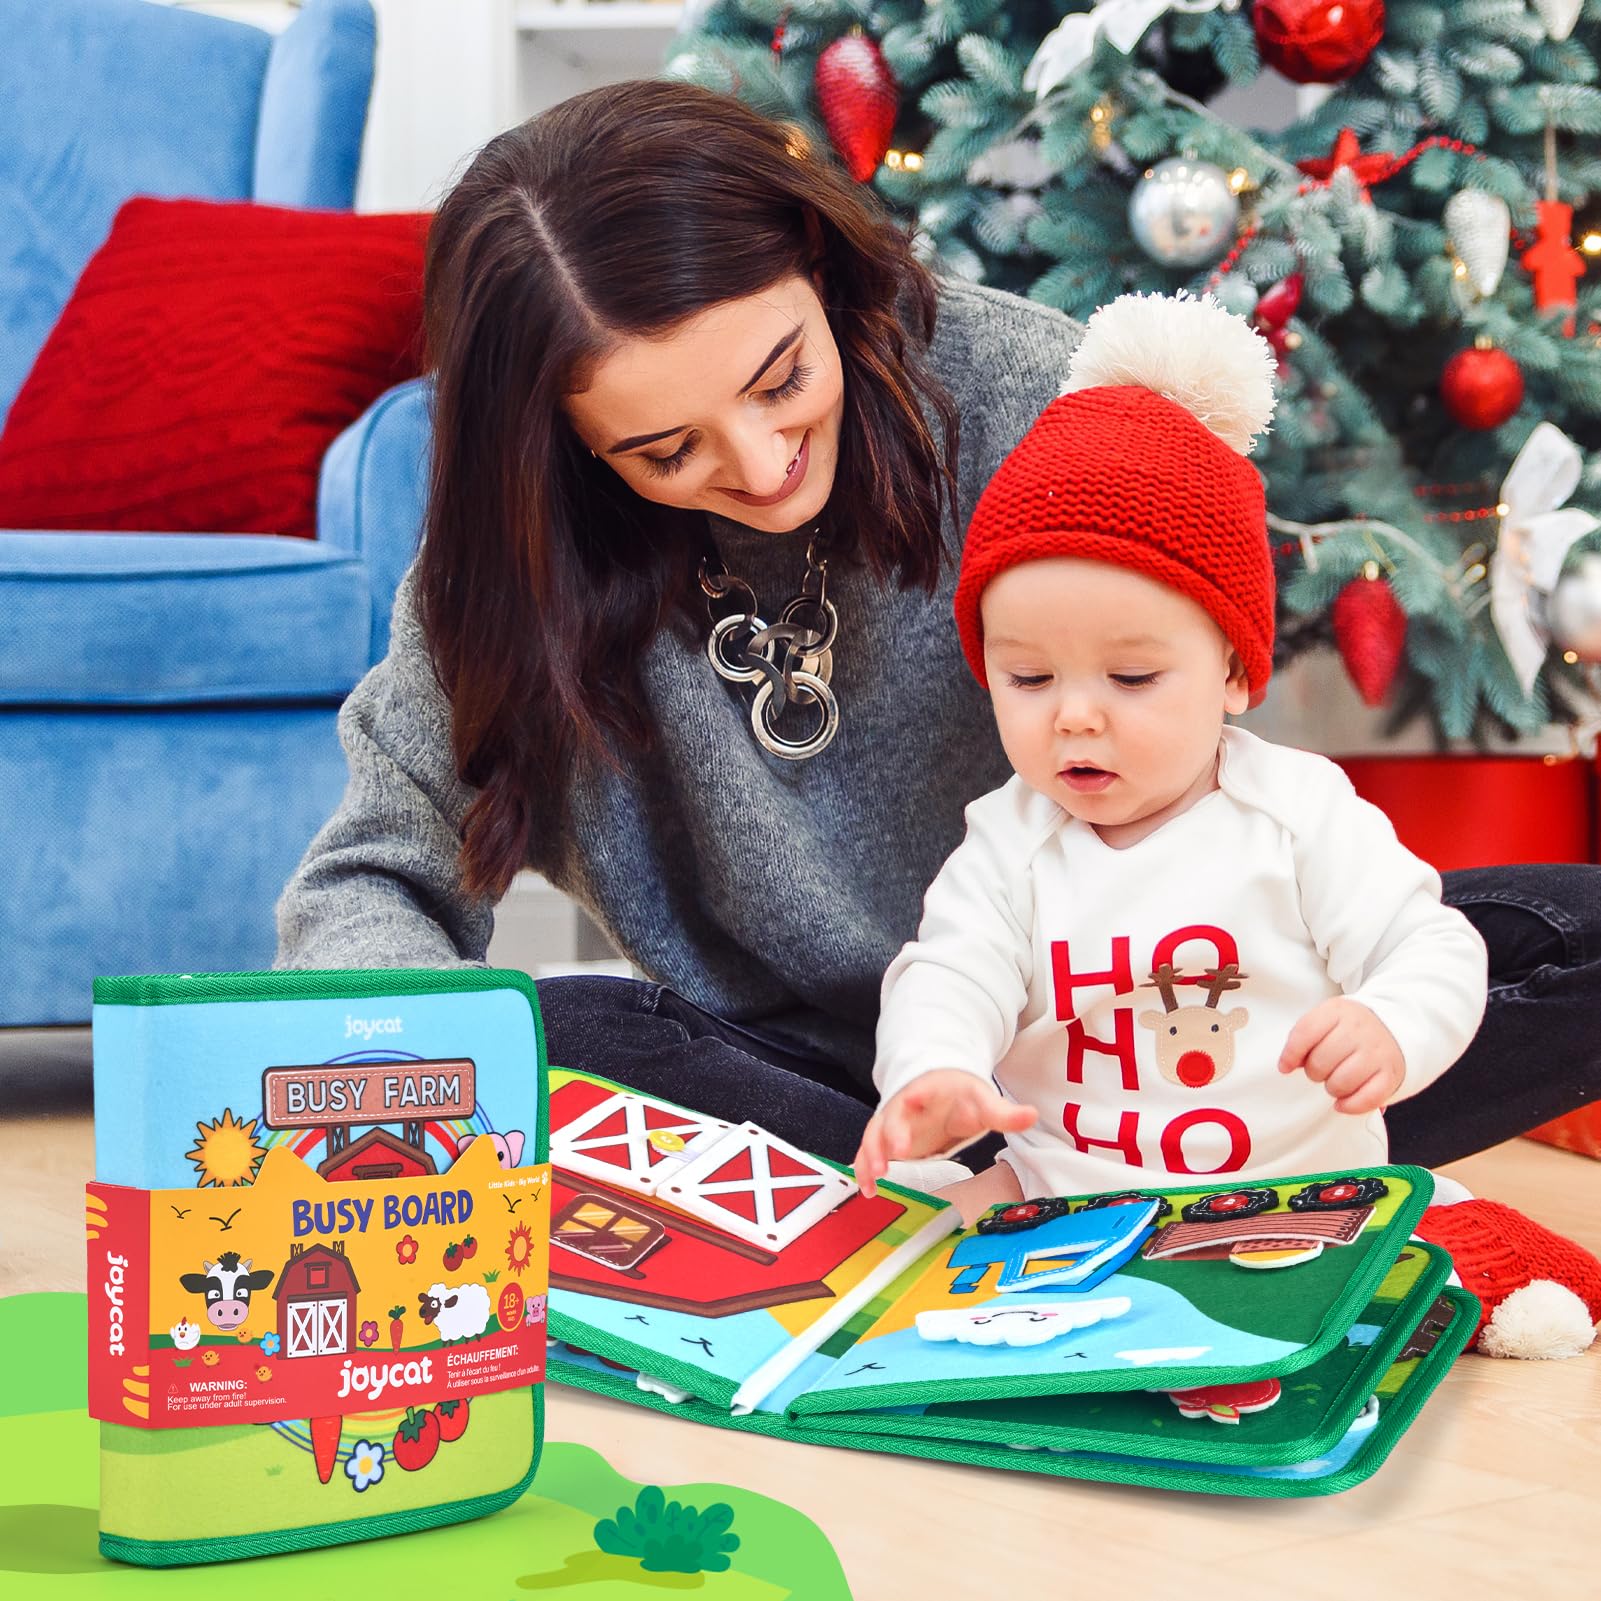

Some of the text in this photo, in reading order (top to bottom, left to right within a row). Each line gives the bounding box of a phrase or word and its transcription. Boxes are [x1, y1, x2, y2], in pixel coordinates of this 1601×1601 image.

[1051, 924, 1239, 1021] HO
[344, 1014, 404, 1040] joycat
[286, 1074, 461, 1114] BUSY FARM
[1063, 1102, 1251, 1174] HO
[488, 1181, 503, 1189] Little
[504, 1180, 516, 1188] Kids
[527, 1176, 540, 1184] World
[292, 1189, 474, 1237] BUSY BOARD
[105, 1250, 128, 1356] joycat
[503, 1292, 520, 1309] 18+
[447, 1344, 519, 1367] ÉCHAUFFEMENT:
[337, 1356, 433, 1400] joycat
[447, 1369, 461, 1379] Tenir
[482, 1365, 490, 1374] du
[490, 1364, 498, 1373] feu
[452, 1378, 471, 1388] utiliser
[470, 1376, 484, 1386] sous
[484, 1375, 489, 1383] la
[489, 1370, 517, 1382] surveillance
[167, 1391, 247, 1404] Keep away from fire!
[189, 1379, 248, 1393] WARNING:
[167, 1403, 181, 1411] For
[199, 1401, 222, 1409] under
[223, 1399, 243, 1408] adult
[244, 1397, 287, 1408] supervision.
